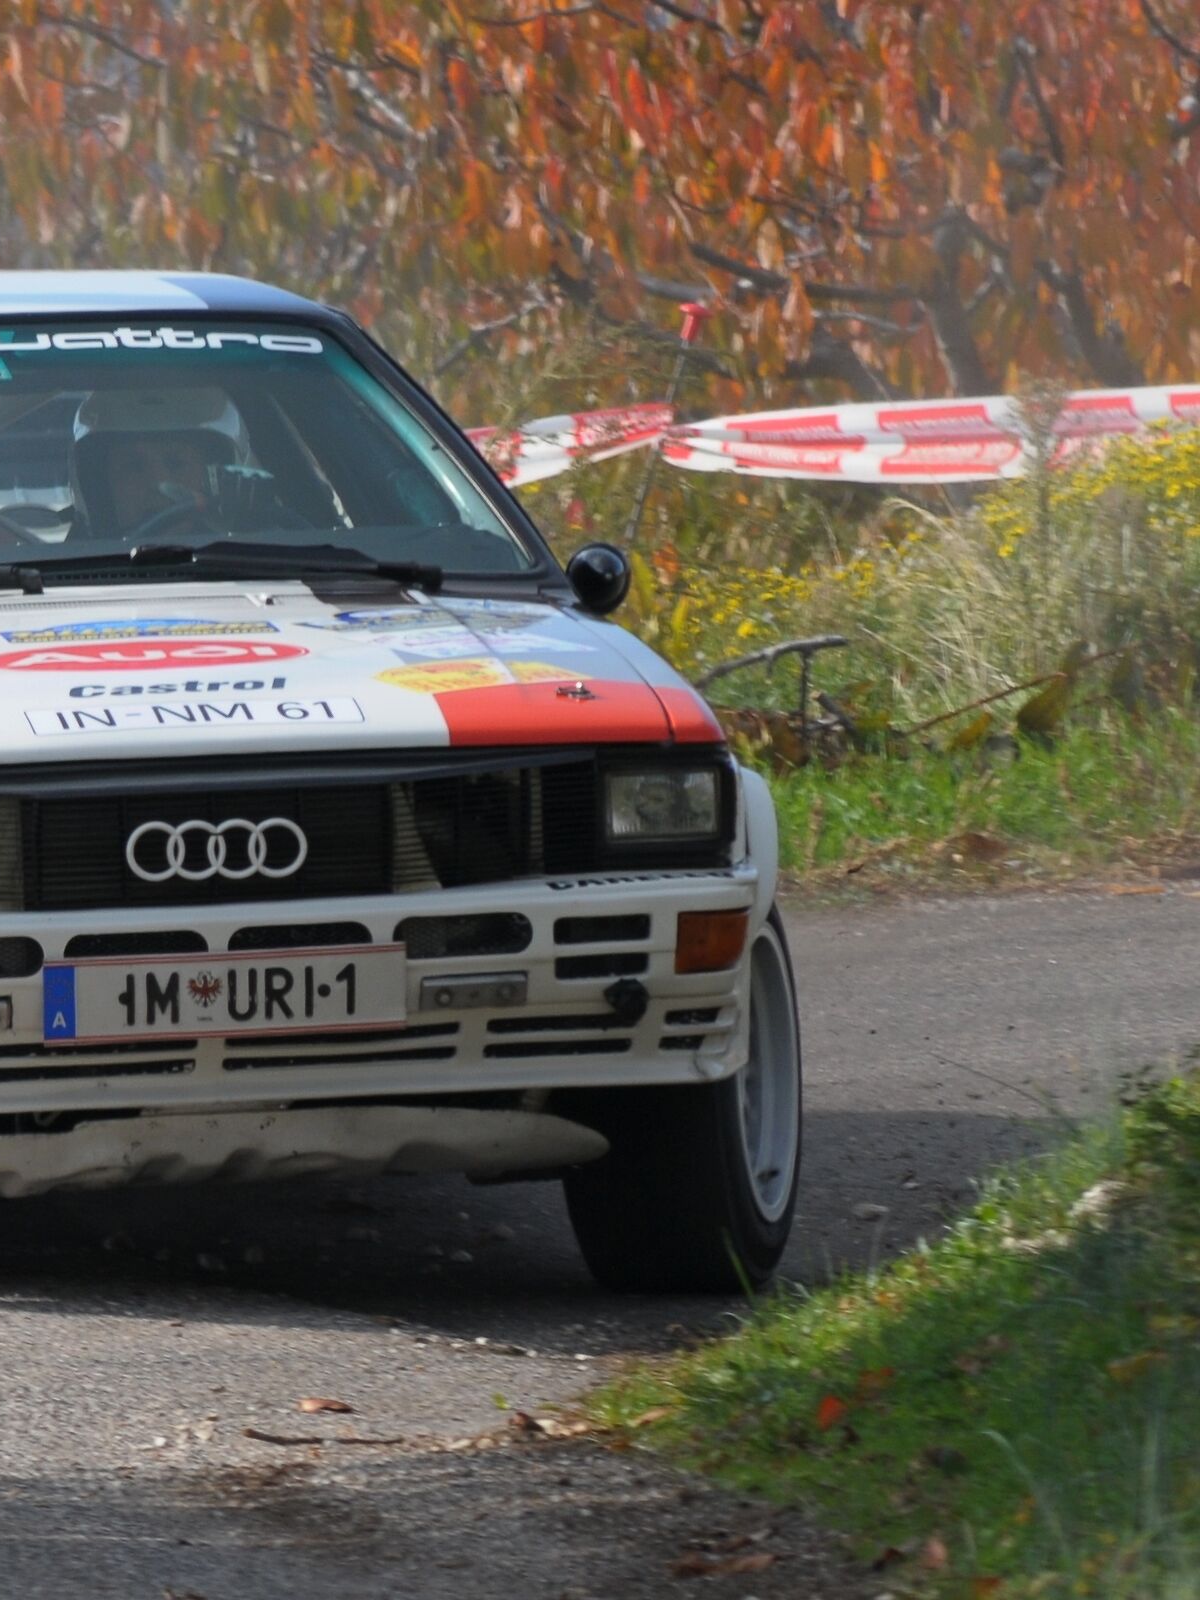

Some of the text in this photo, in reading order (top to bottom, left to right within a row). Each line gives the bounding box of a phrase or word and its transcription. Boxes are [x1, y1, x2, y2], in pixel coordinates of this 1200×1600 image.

[67, 676, 287, 699] Castrol
[276, 701, 335, 721] 61
[51, 1010, 67, 1029] A
